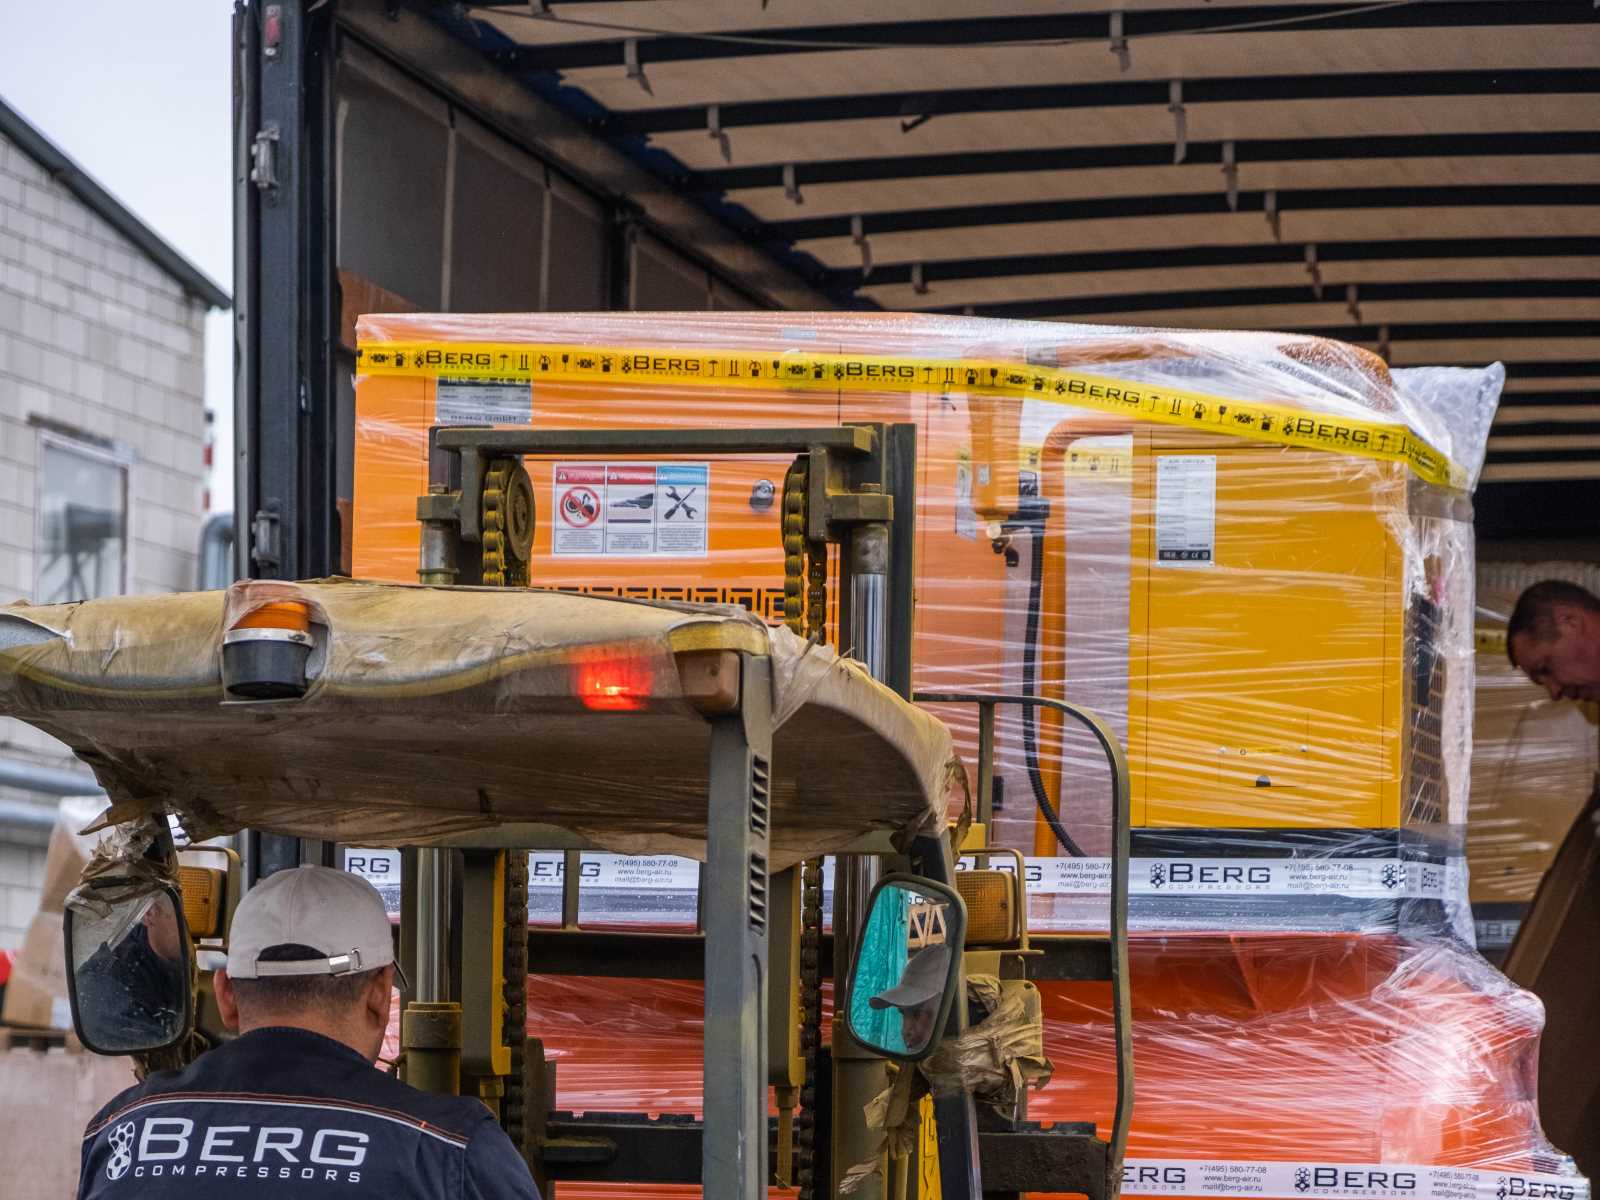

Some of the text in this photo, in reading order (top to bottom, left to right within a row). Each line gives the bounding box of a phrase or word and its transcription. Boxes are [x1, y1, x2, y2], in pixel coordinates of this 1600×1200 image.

[426, 350, 491, 366] BERG
[633, 355, 700, 371] BERG
[846, 361, 915, 378] BERG
[1068, 379, 1141, 404] BERG
[1296, 417, 1370, 443] BERG
[1169, 863, 1271, 883] BERG
[138, 1117, 370, 1167] BERG
[134, 1164, 361, 1184] COMPRESSORS
[1313, 1167, 1417, 1189] BERG
[1509, 1176, 1575, 1200] BERG
